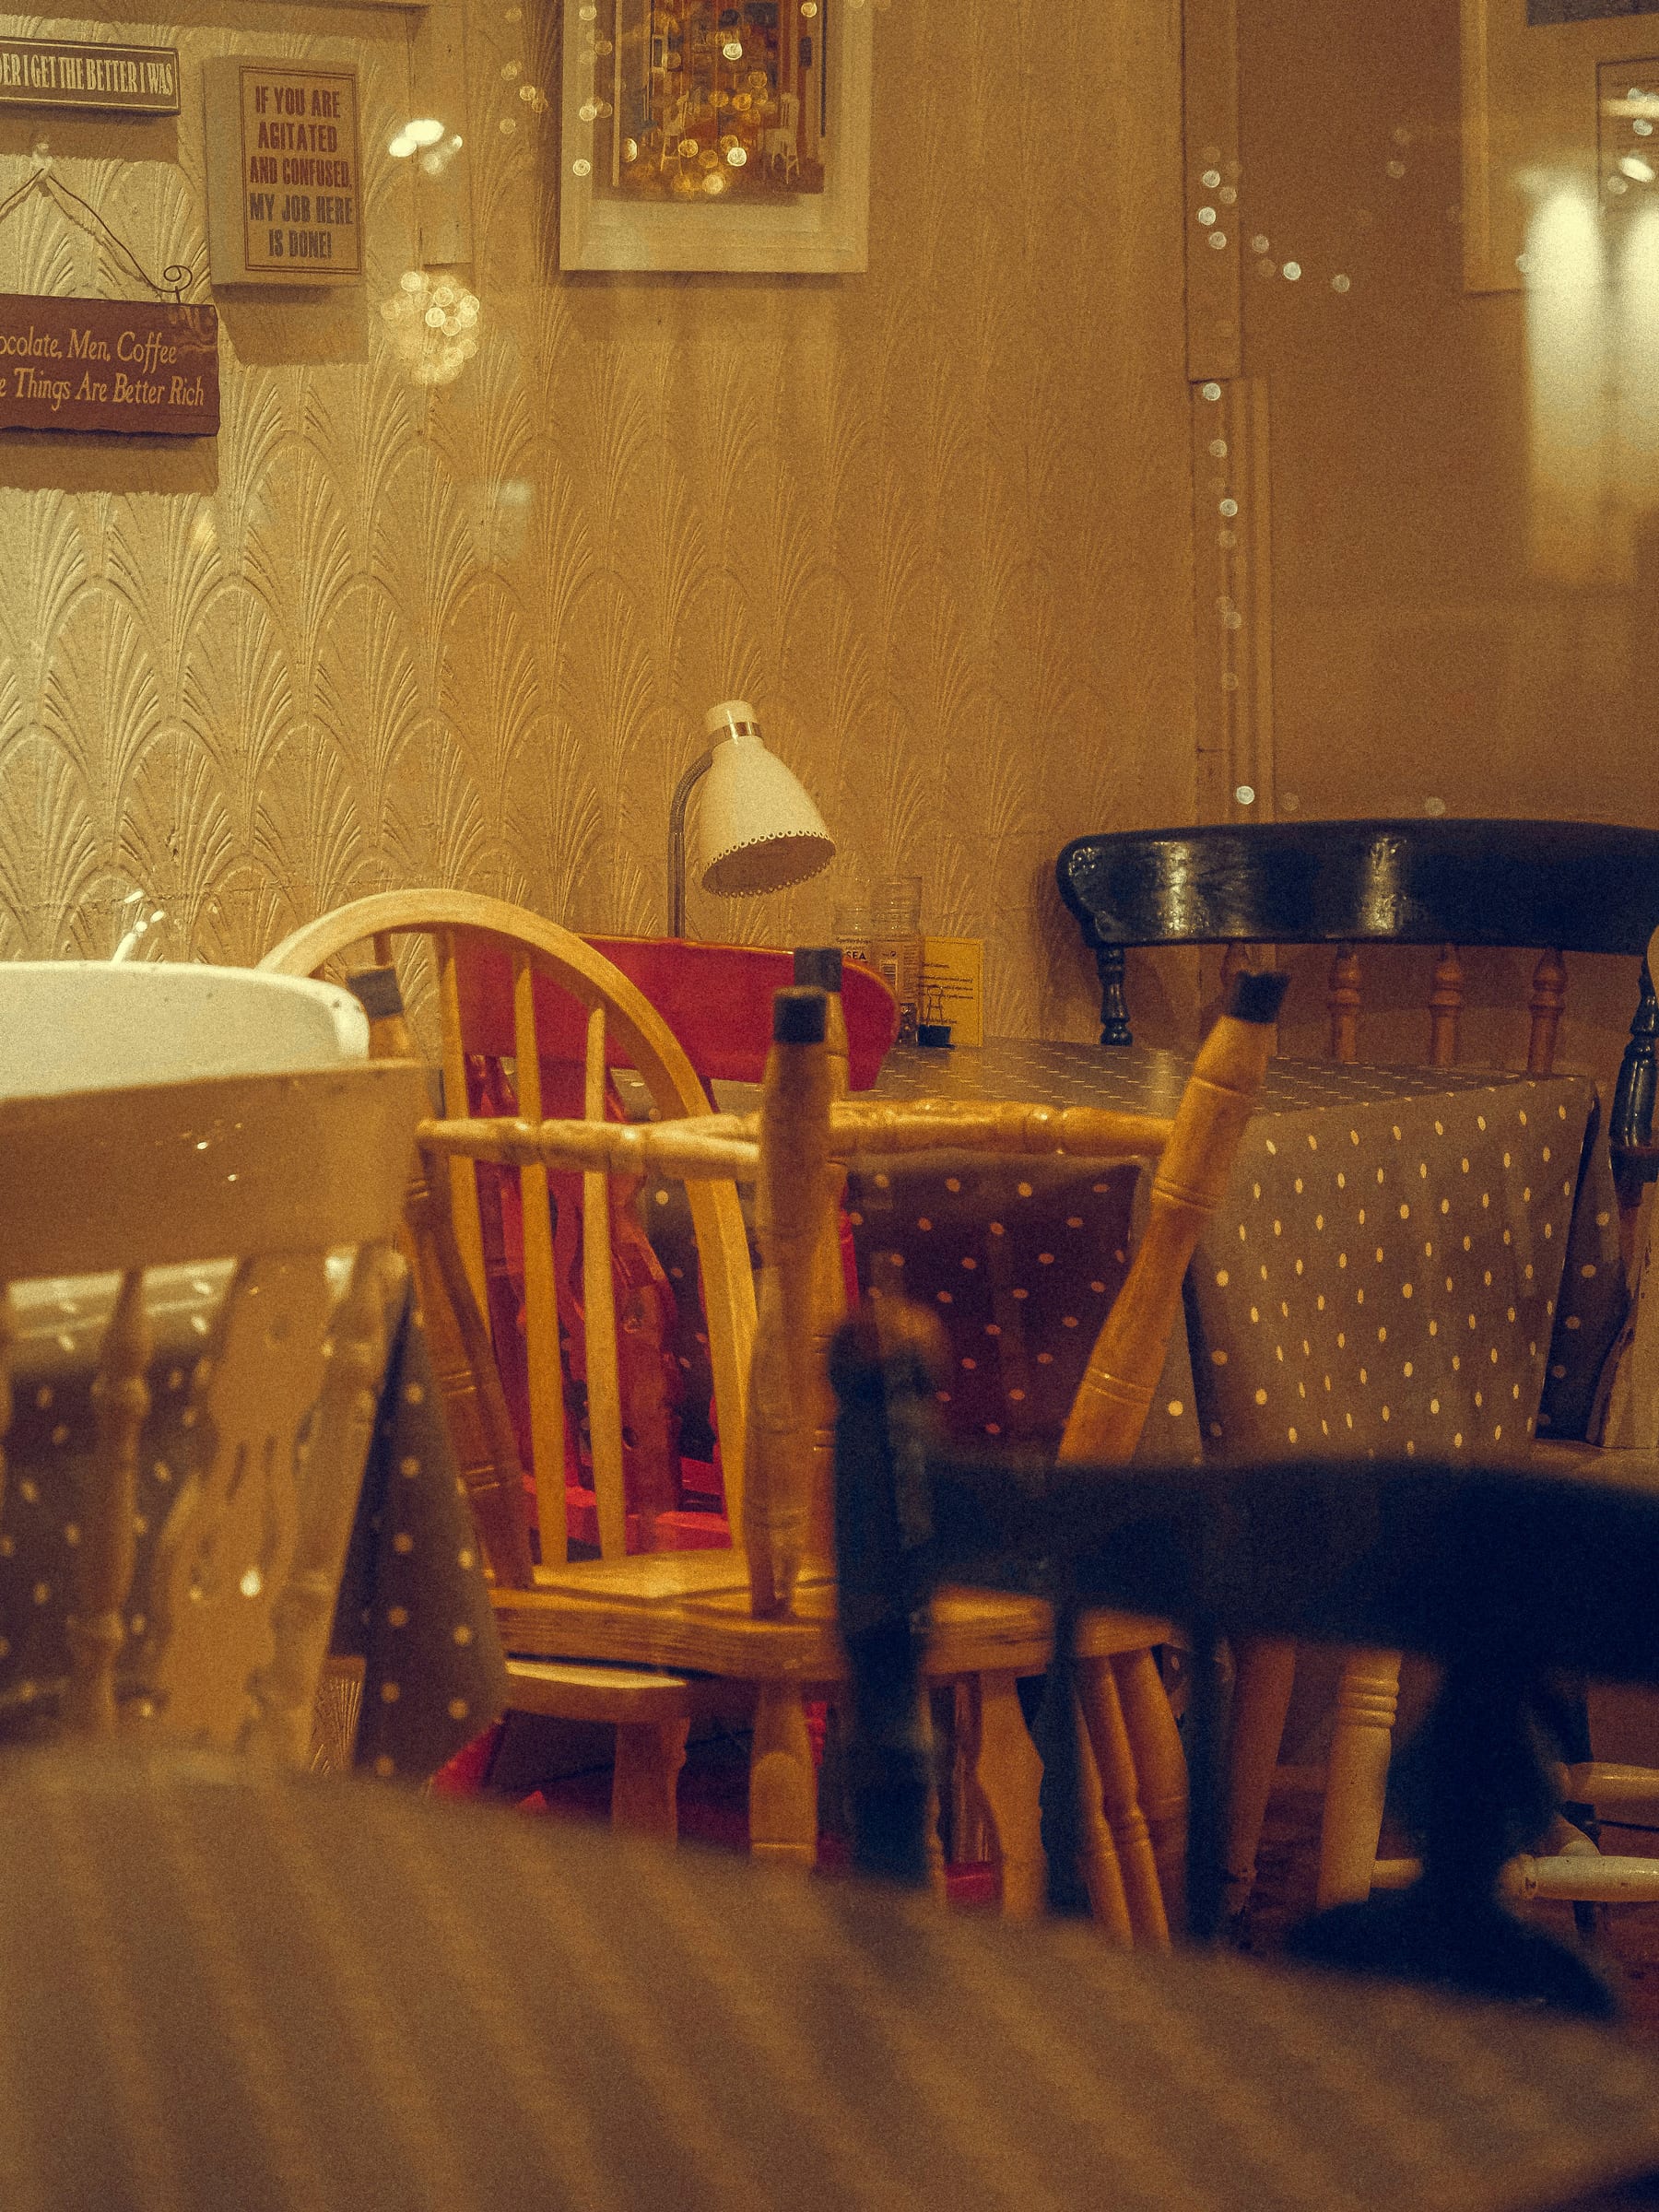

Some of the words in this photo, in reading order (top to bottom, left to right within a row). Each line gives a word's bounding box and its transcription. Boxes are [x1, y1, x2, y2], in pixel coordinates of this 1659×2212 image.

[0, 53, 21, 86] ER
[23, 54, 29, 87] I
[30, 54, 56, 88] GET
[58, 56, 84, 89] THE
[86, 58, 137, 93] BETTER
[139, 61, 146, 93] I
[147, 62, 173, 96] WAS
[255, 85, 269, 114] IF
[274, 87, 306, 117] YOU
[311, 89, 341, 118] ARE
[257, 121, 338, 153] AGITATED
[250, 156, 278, 184] AND
[282, 158, 353, 191] CONFUSED,
[249, 193, 276, 222] MY
[281, 194, 311, 223] JOB
[316, 195, 354, 225] HERE
[268, 229, 284, 258] IS
[288, 229, 333, 259] DONE!
[117, 331, 178, 374] Coffee
[14, 368, 72, 412] Things
[75, 371, 107, 402] Are
[112, 372, 166, 405] Better
[168, 375, 205, 406] Rich
